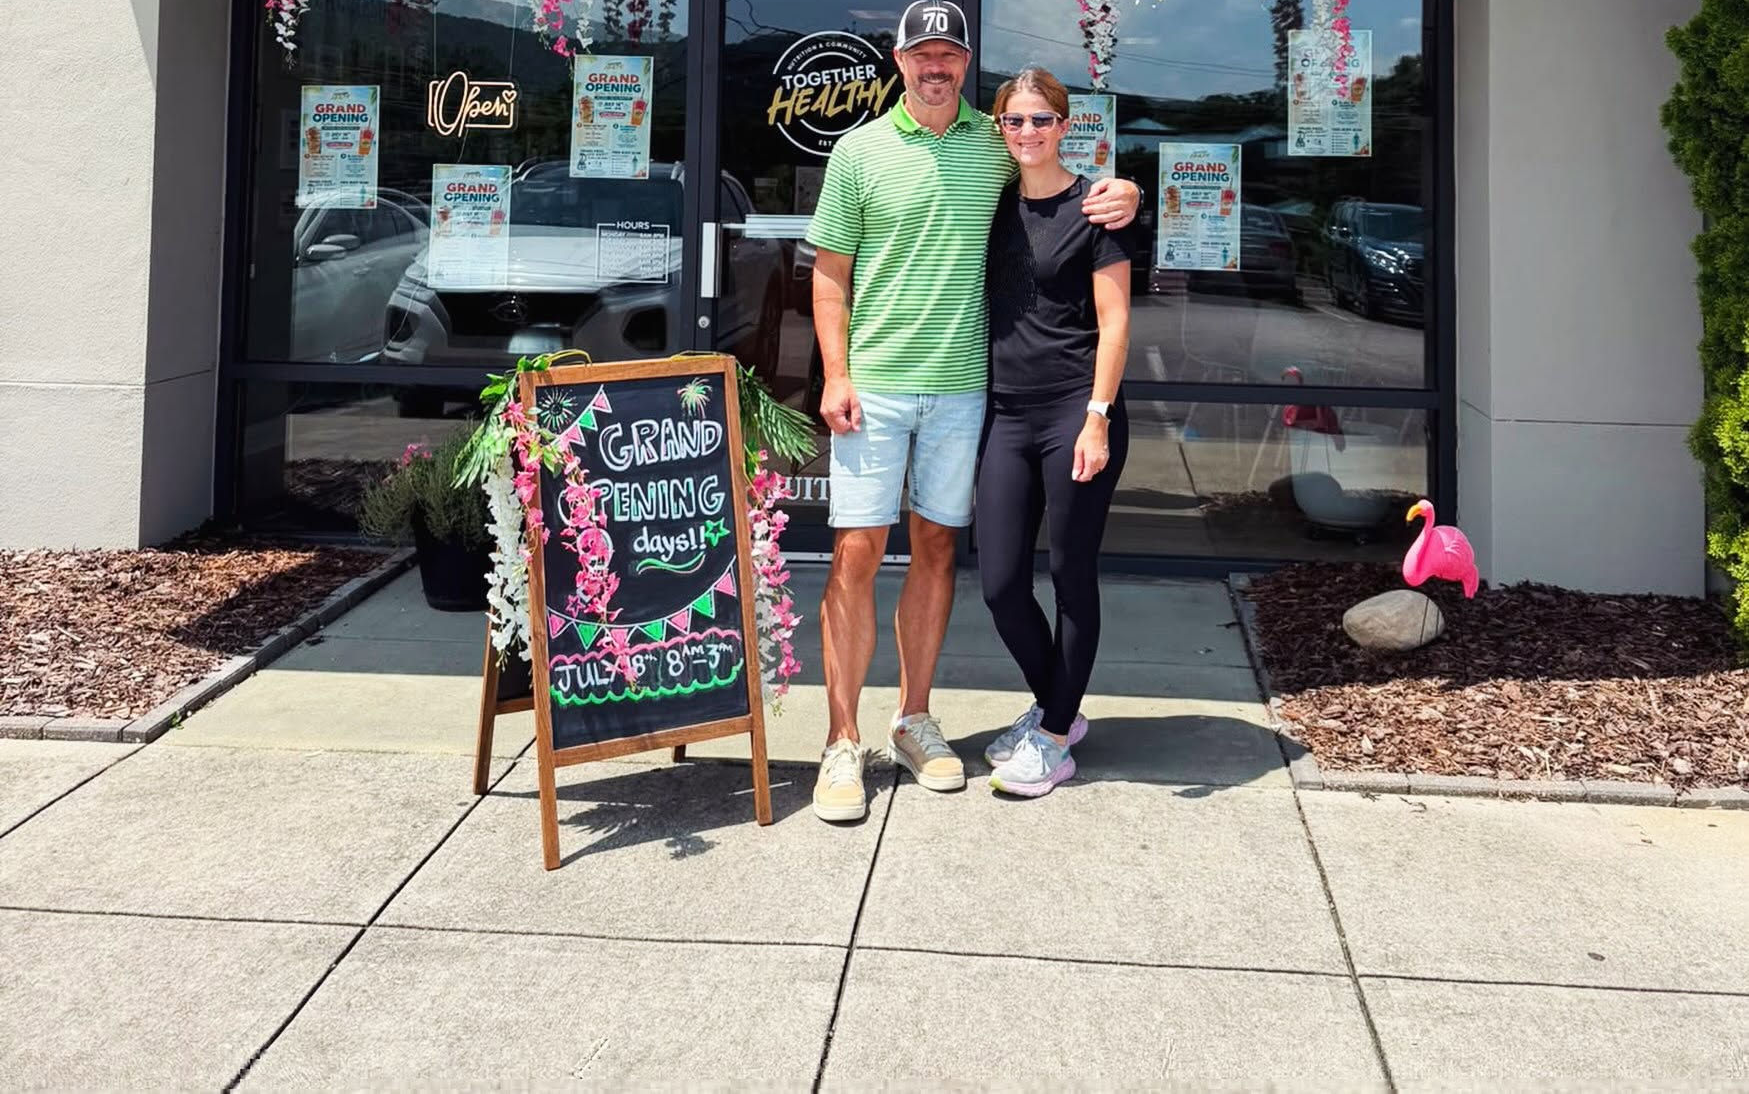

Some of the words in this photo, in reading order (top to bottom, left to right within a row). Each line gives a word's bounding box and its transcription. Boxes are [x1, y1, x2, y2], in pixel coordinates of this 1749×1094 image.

[922, 12, 949, 33] 70
[787, 43, 818, 71] NUTRITION
[825, 42, 868, 59] COMMUNITY
[588, 73, 639, 83] GRAND
[781, 64, 877, 90] TOGETHER
[585, 83, 642, 93] OPENING
[434, 71, 509, 137] Open
[767, 74, 898, 126] HEALTHY
[315, 104, 366, 113] GRAND
[312, 113, 369, 123] OPENING
[1071, 113, 1102, 123] AND
[1073, 123, 1105, 132] NING
[1174, 162, 1227, 173] GRAND
[1171, 172, 1230, 183] OPENING
[446, 183, 498, 193] GRAND
[443, 193, 501, 203] OPENING
[616, 221, 650, 230] HOURS
[599, 418, 723, 472] GRAND
[785, 476, 831, 500] UIT
[633, 526, 708, 562] days!!
[554, 655, 622, 693] JULY
